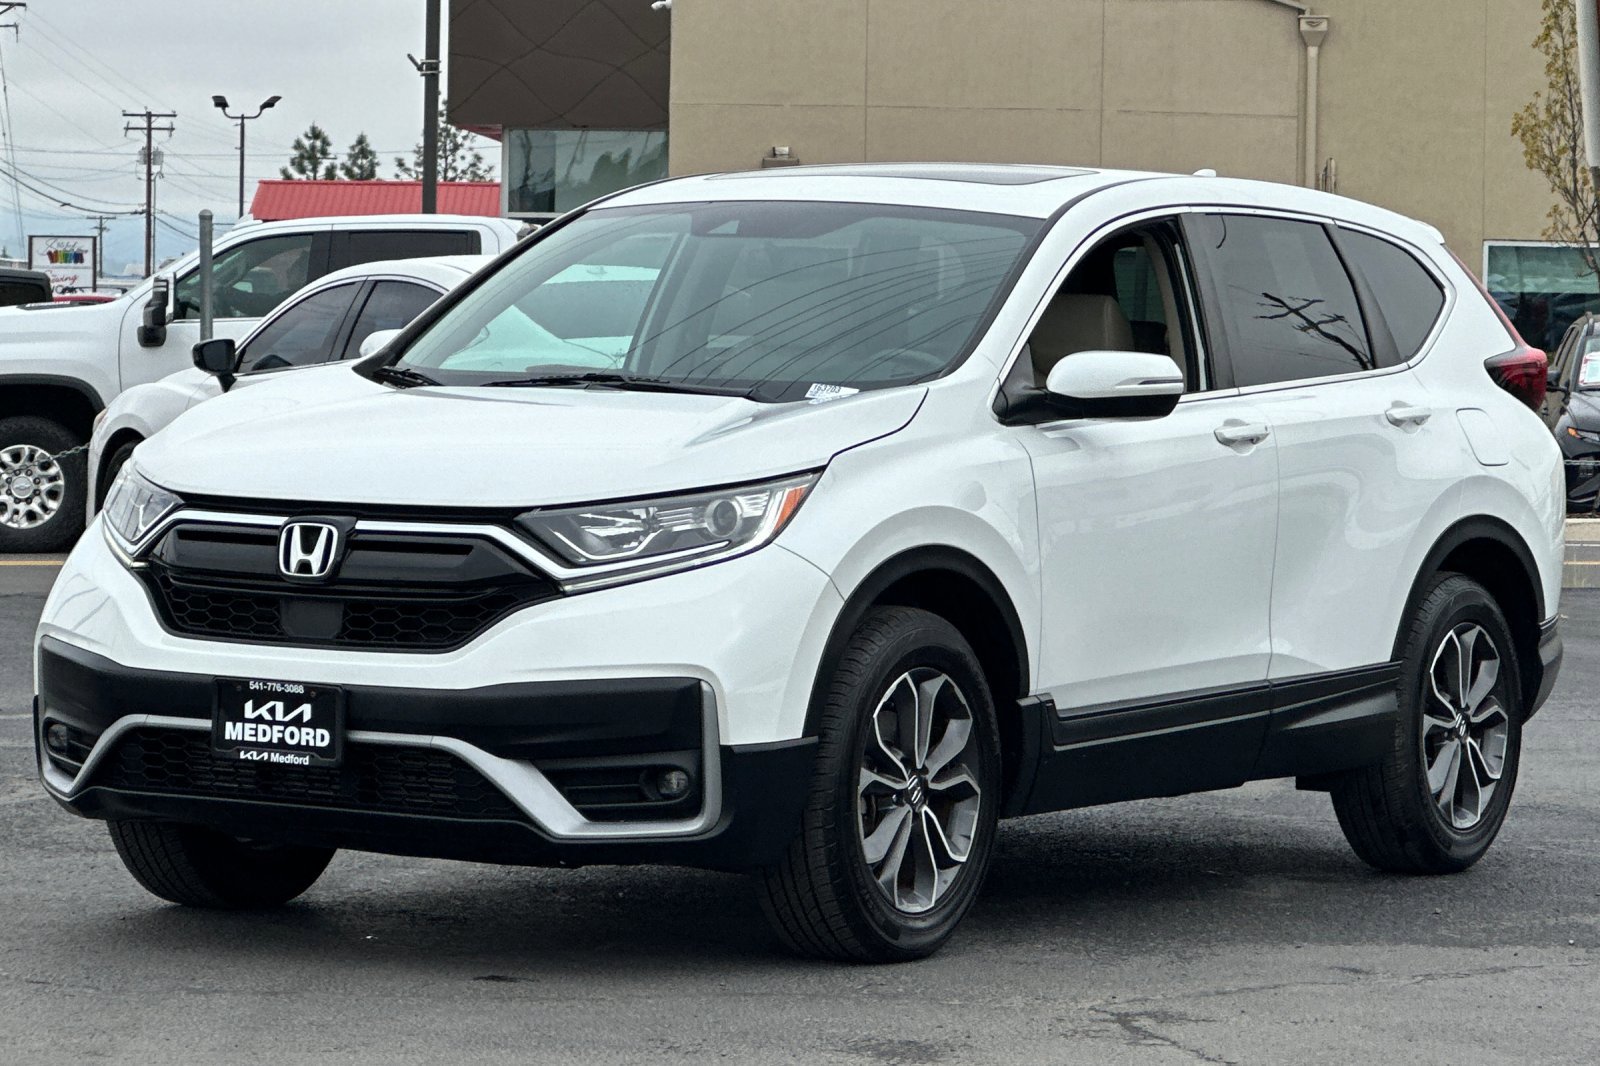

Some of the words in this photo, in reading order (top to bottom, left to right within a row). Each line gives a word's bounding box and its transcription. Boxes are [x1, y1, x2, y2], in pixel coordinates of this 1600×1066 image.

[244, 699, 312, 723] KIA
[224, 721, 331, 747] MEDFORD
[239, 750, 268, 761] KIA
[270, 752, 310, 765] Medford
